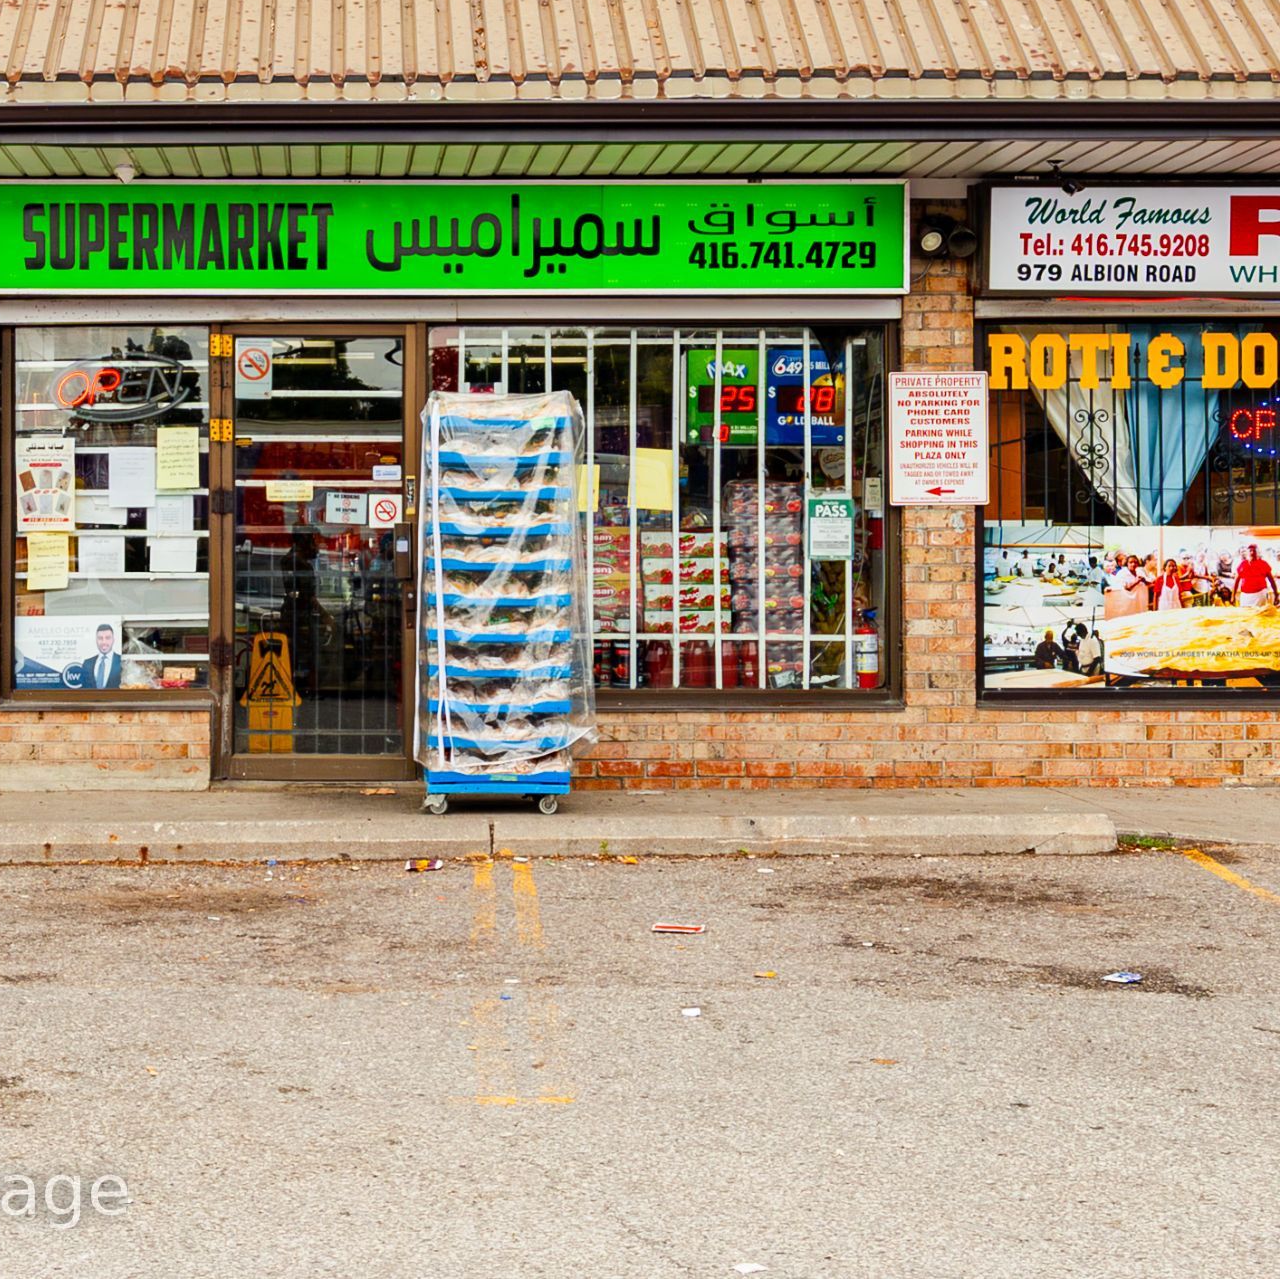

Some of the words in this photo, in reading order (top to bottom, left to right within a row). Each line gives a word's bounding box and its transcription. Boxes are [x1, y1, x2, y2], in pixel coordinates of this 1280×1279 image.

[687, 196, 878, 235] أسواق
[1024, 197, 1107, 225] World
[1112, 197, 1212, 230] Famous
[22, 202, 335, 271] SUPERMARKET
[365, 192, 661, 278] سميراميس
[1019, 233, 1064, 256] Tel.:
[1071, 233, 1210, 257] 416.745.9208
[687, 241, 877, 269] 416.741.4729
[1017, 263, 1062, 282] 979
[1070, 264, 1138, 282] ALBION
[1146, 264, 1196, 282] ROAD
[1229, 265, 1278, 283] WH
[988, 333, 1131, 390] ROTI
[1201, 332, 1278, 389] DO
[58, 367, 182, 406] OPEN
[895, 377, 933, 387] PRIVATE
[935, 376, 981, 387] PROPERTY
[720, 386, 756, 412] 25
[897, 399, 911, 407] NO
[914, 399, 958, 407] PARKING
[960, 399, 980, 407] FOR
[908, 390, 969, 398] ABSOLUTELY
[810, 416, 835, 426] BALL
[910, 417, 971, 425] CUSTOMERS
[905, 429, 943, 437] PARKING
[945, 429, 973, 437] WHILE
[899, 440, 945, 448] SHOPPING
[947, 440, 956, 448] IN
[960, 440, 978, 448] THIS
[914, 451, 942, 460] PLAZA
[944, 451, 967, 460] ONLY
[815, 505, 848, 518] PASS
